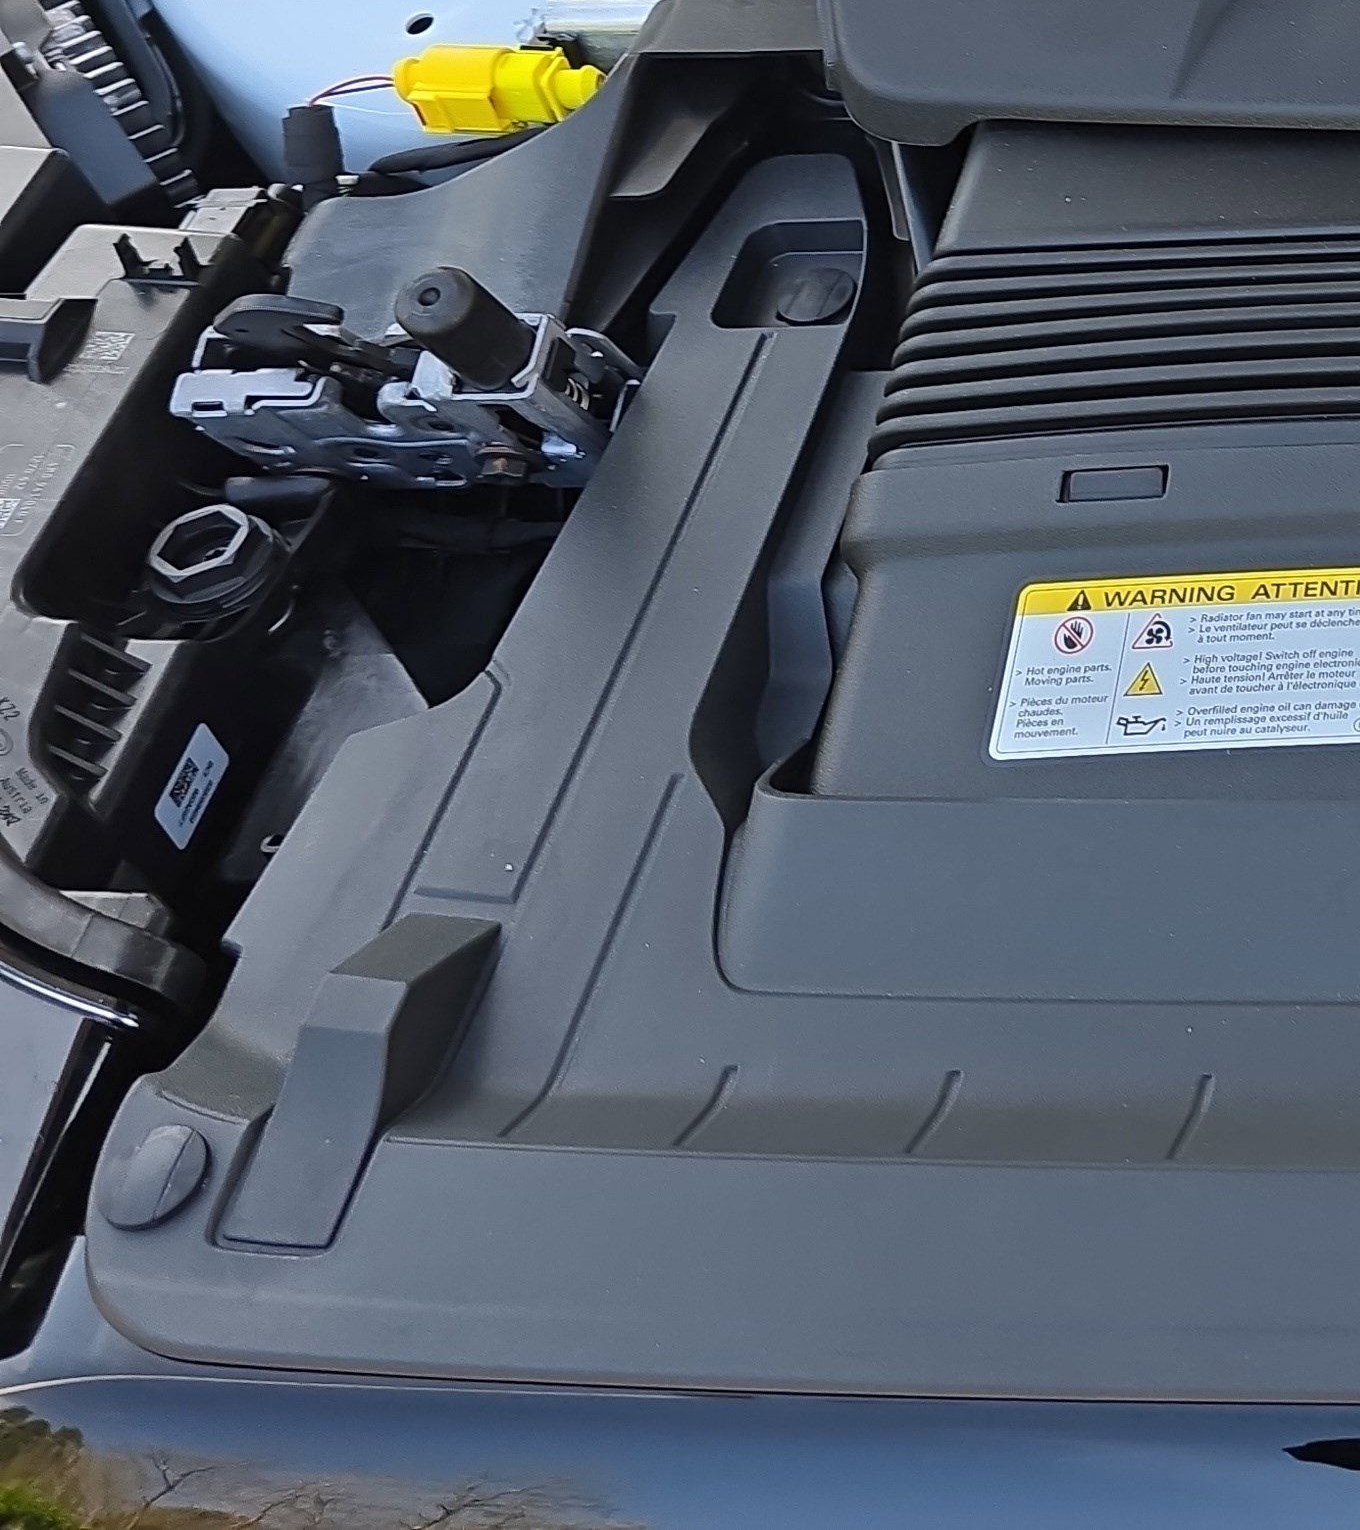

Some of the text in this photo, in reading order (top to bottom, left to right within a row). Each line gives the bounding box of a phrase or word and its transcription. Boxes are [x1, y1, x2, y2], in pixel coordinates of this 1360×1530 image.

[1103, 584, 1236, 607] WARNING
[1200, 612, 1243, 623] Radiator
[1245, 611, 1262, 621] fan
[1263, 611, 1288, 622] may
[1289, 609, 1313, 619] start
[1314, 609, 1325, 618] at
[1326, 609, 1346, 619] any
[1199, 624, 1211, 633] Le
[1213, 622, 1268, 633] ventilateur
[1270, 621, 1293, 631] peut
[1295, 621, 1308, 629] se
[1205, 633, 1228, 643] tout
[1230, 632, 1275, 642] moment.
[1194, 648, 1354, 666] High voltage! Switch off engine
[1026, 663, 1112, 677] Hot engine parts.
[1192, 664, 1226, 674] before
[1228, 662, 1274, 673] touching
[1275, 660, 1311, 671] engine
[1024, 675, 1094, 686] Moving parts.
[1191, 669, 1356, 684] Haute tension! Arrêter le moteur
[1188, 686, 1218, 695] avant
[1219, 684, 1233, 694] de
[1235, 682, 1276, 693] toucher
[1020, 695, 1109, 707] Pièces du moteur
[1187, 704, 1238, 716] Overfilled
[1239, 703, 1276, 715] engine
[1277, 702, 1291, 712] oil
[1293, 703, 1312, 711] can
[1314, 700, 1356, 712] damage
[1017, 707, 1063, 718] chaudes.
[1185, 711, 1349, 728] Un remplissage excessif d'huile
[1016, 718, 1064, 728] Pièces en
[1014, 727, 1079, 739] mouvement.
[1184, 724, 1311, 739] peut nuire au catalyseur.
[15, 767, 49, 805] Made in
[0, 777, 33, 814] Austria
